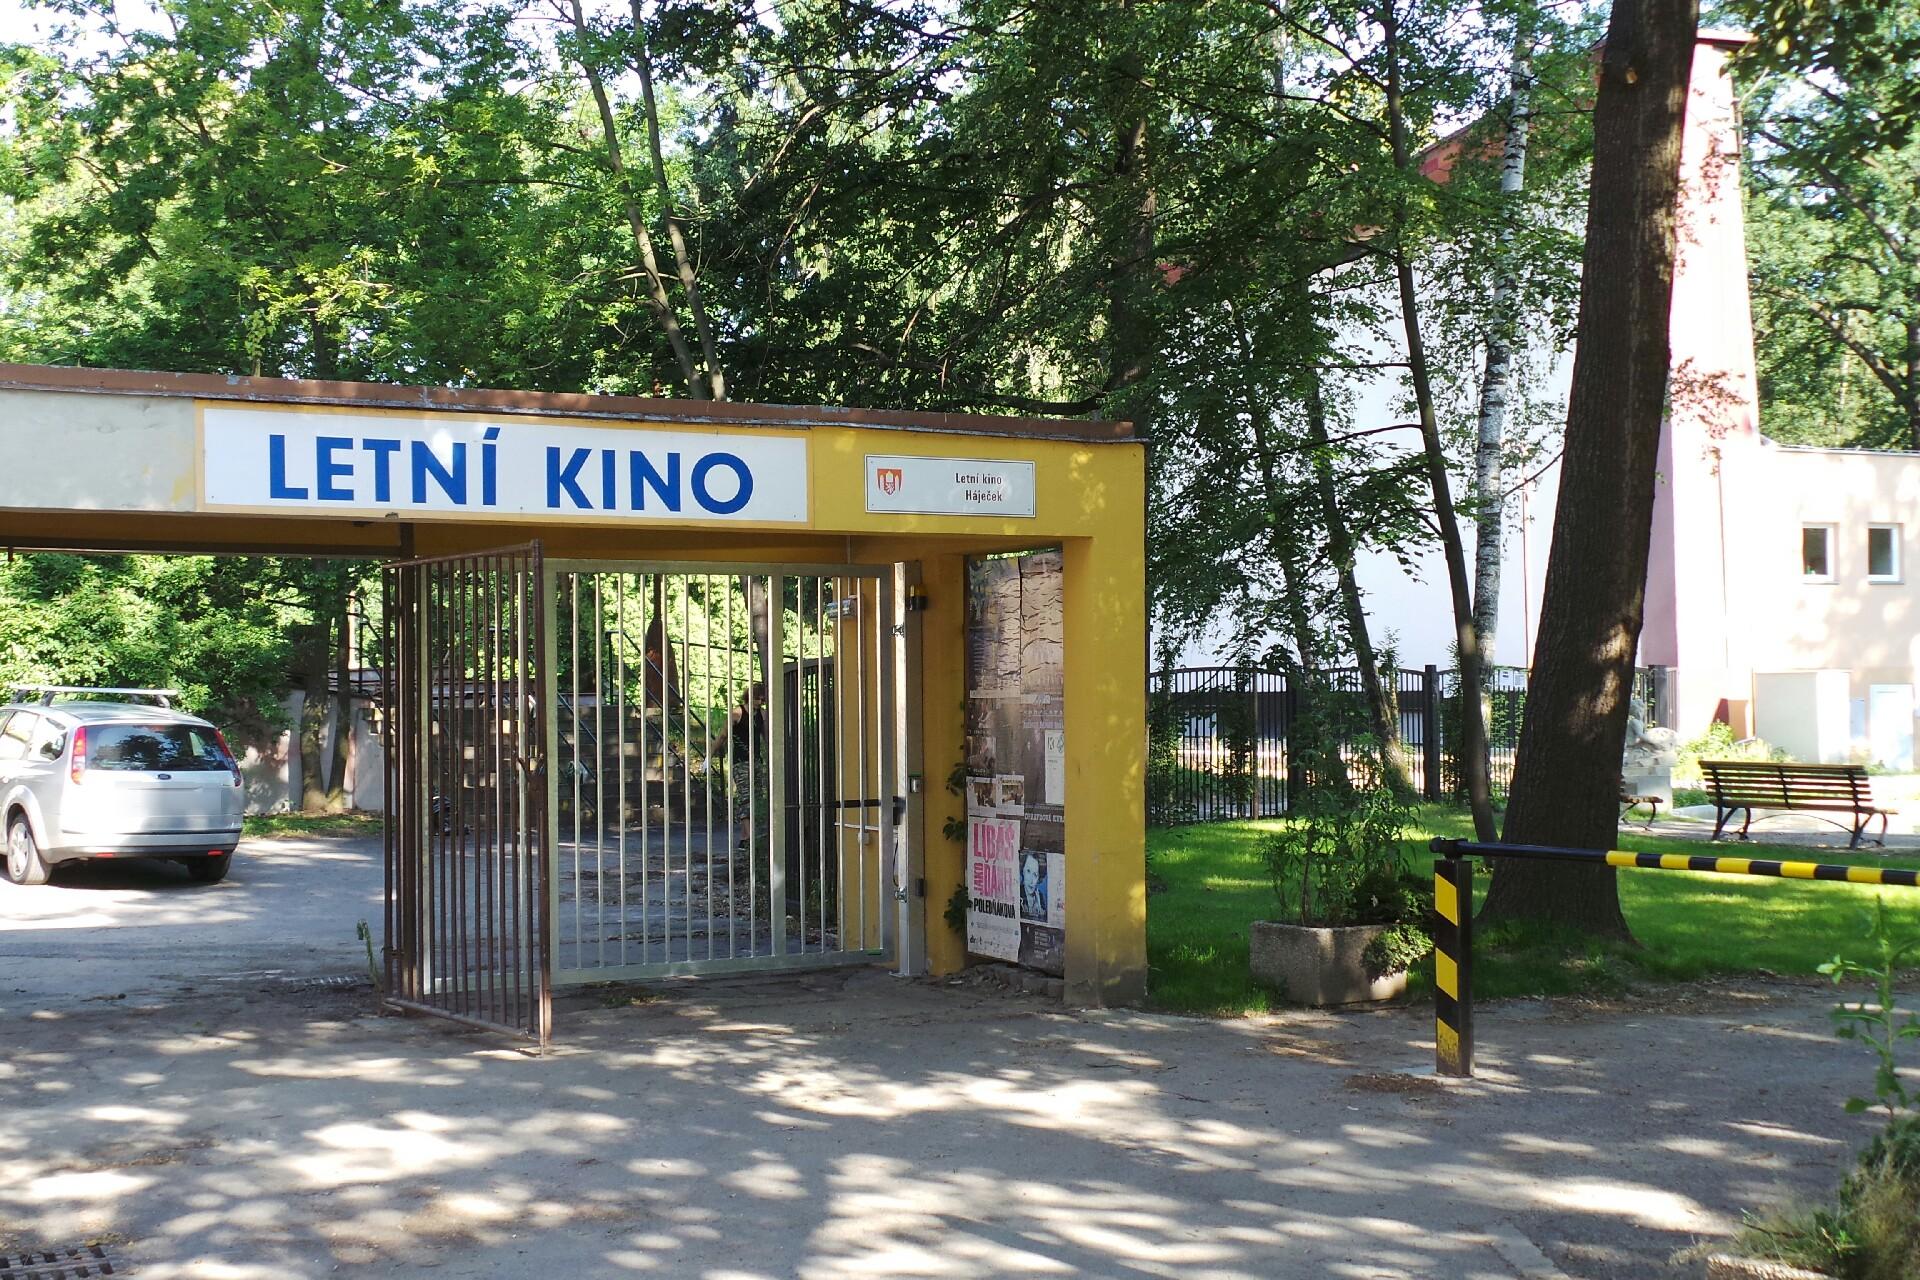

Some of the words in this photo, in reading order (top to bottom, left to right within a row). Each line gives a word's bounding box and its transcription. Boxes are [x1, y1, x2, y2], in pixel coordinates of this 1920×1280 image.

[269, 427, 500, 505] LETNÍ
[546, 446, 754, 514] KINO
[955, 473, 979, 484] Letní
[982, 474, 1002, 485] kino
[965, 490, 1002, 503] Háječek
[973, 818, 1015, 862] LÍBÁŠ
